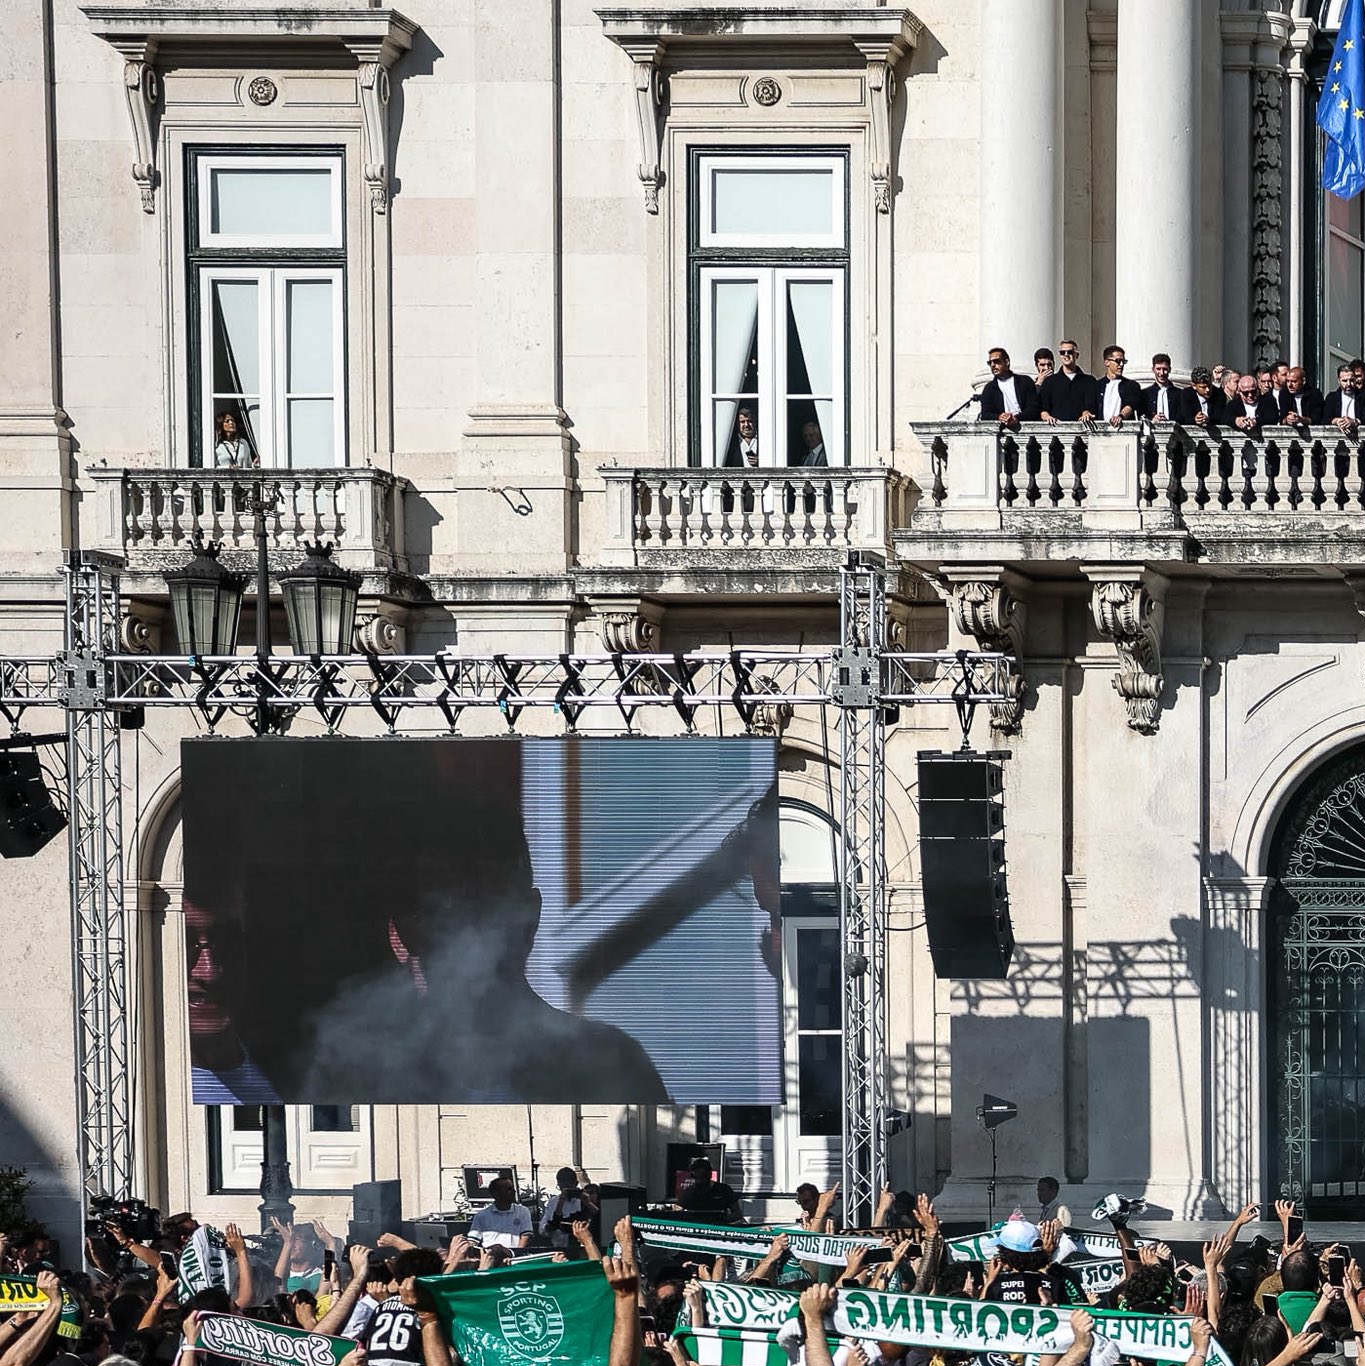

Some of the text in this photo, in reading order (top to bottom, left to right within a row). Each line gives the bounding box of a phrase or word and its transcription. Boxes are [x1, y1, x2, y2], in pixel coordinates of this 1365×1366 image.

[503, 1296, 555, 1315] SPORTING
[373, 1315, 411, 1351] 26
[511, 1336, 561, 1353] PORTUGAL
